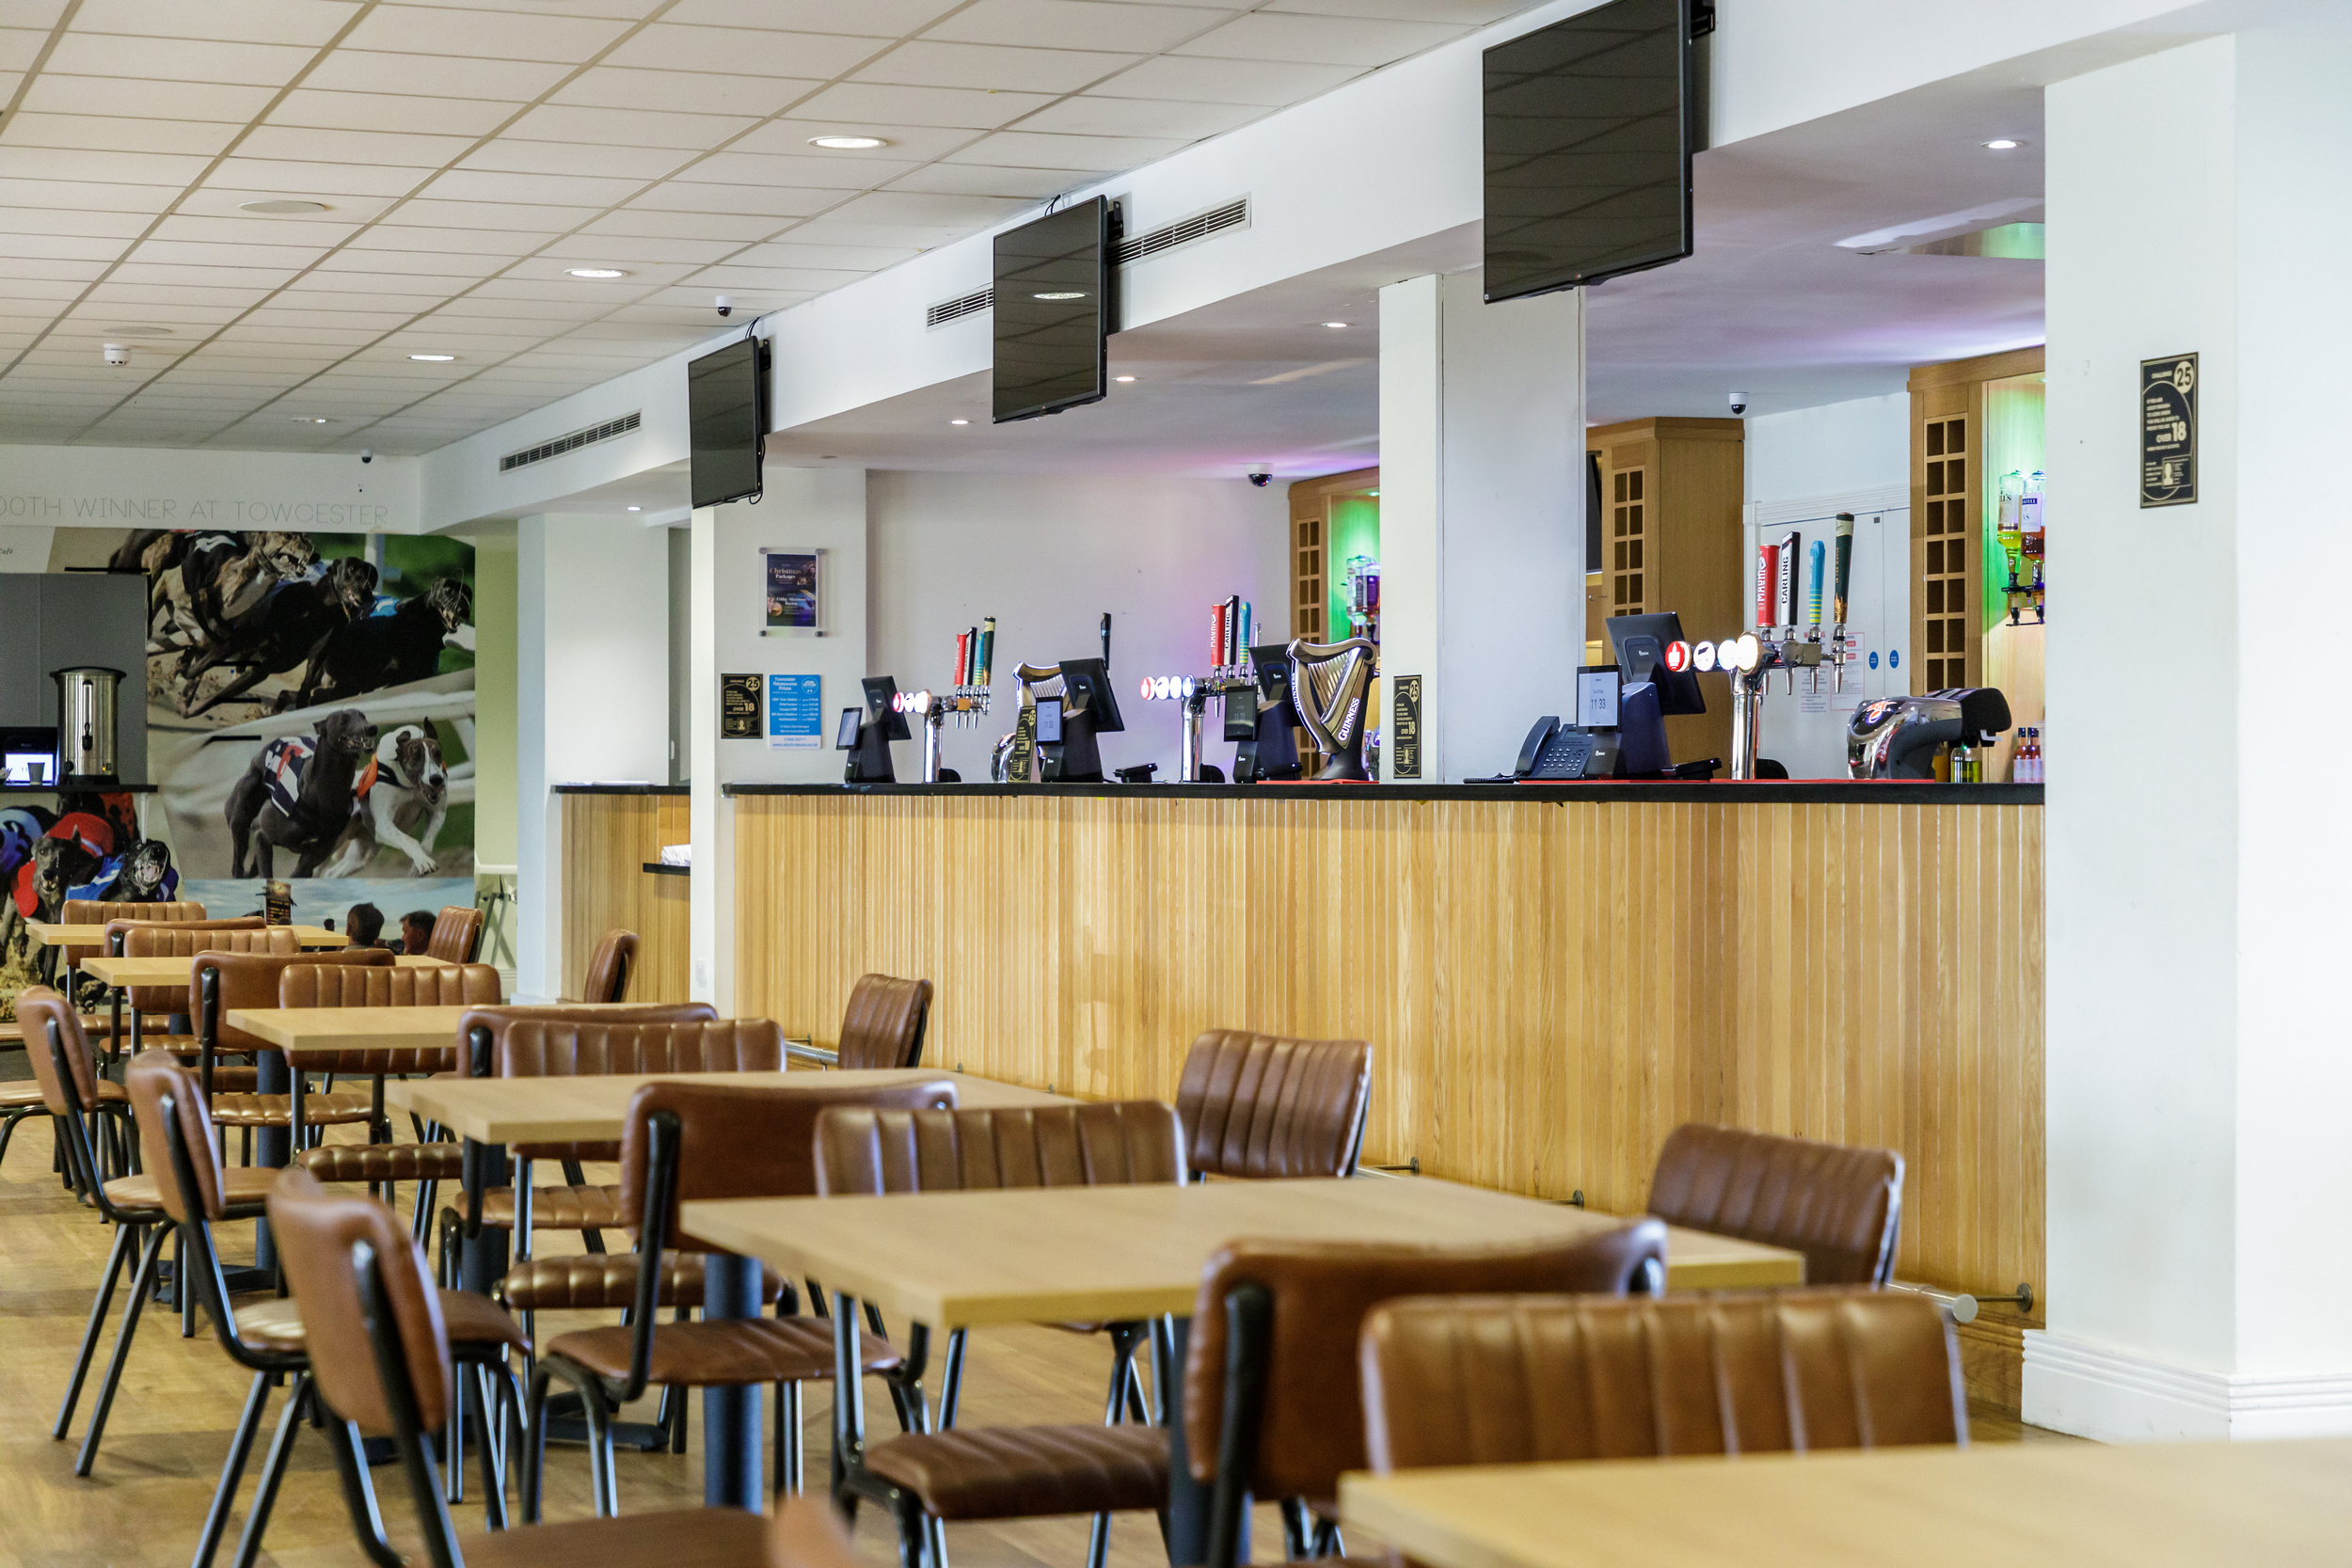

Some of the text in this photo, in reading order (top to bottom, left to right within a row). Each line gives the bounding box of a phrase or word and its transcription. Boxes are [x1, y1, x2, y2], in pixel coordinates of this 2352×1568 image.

[2176, 367, 2192, 388] 25
[2155, 433, 2171, 444] OVER
[2171, 420, 2186, 442] 18
[73, 498, 177, 519] WINNER
[189, 499, 219, 520] AT
[234, 500, 389, 525] TOWCESTER
[747, 679, 759, 689] 25
[1411, 684, 1419, 697] 25
[744, 703, 755, 712] 18
[1338, 697, 1360, 741] GUINNESS
[1408, 721, 1416, 735] 18
